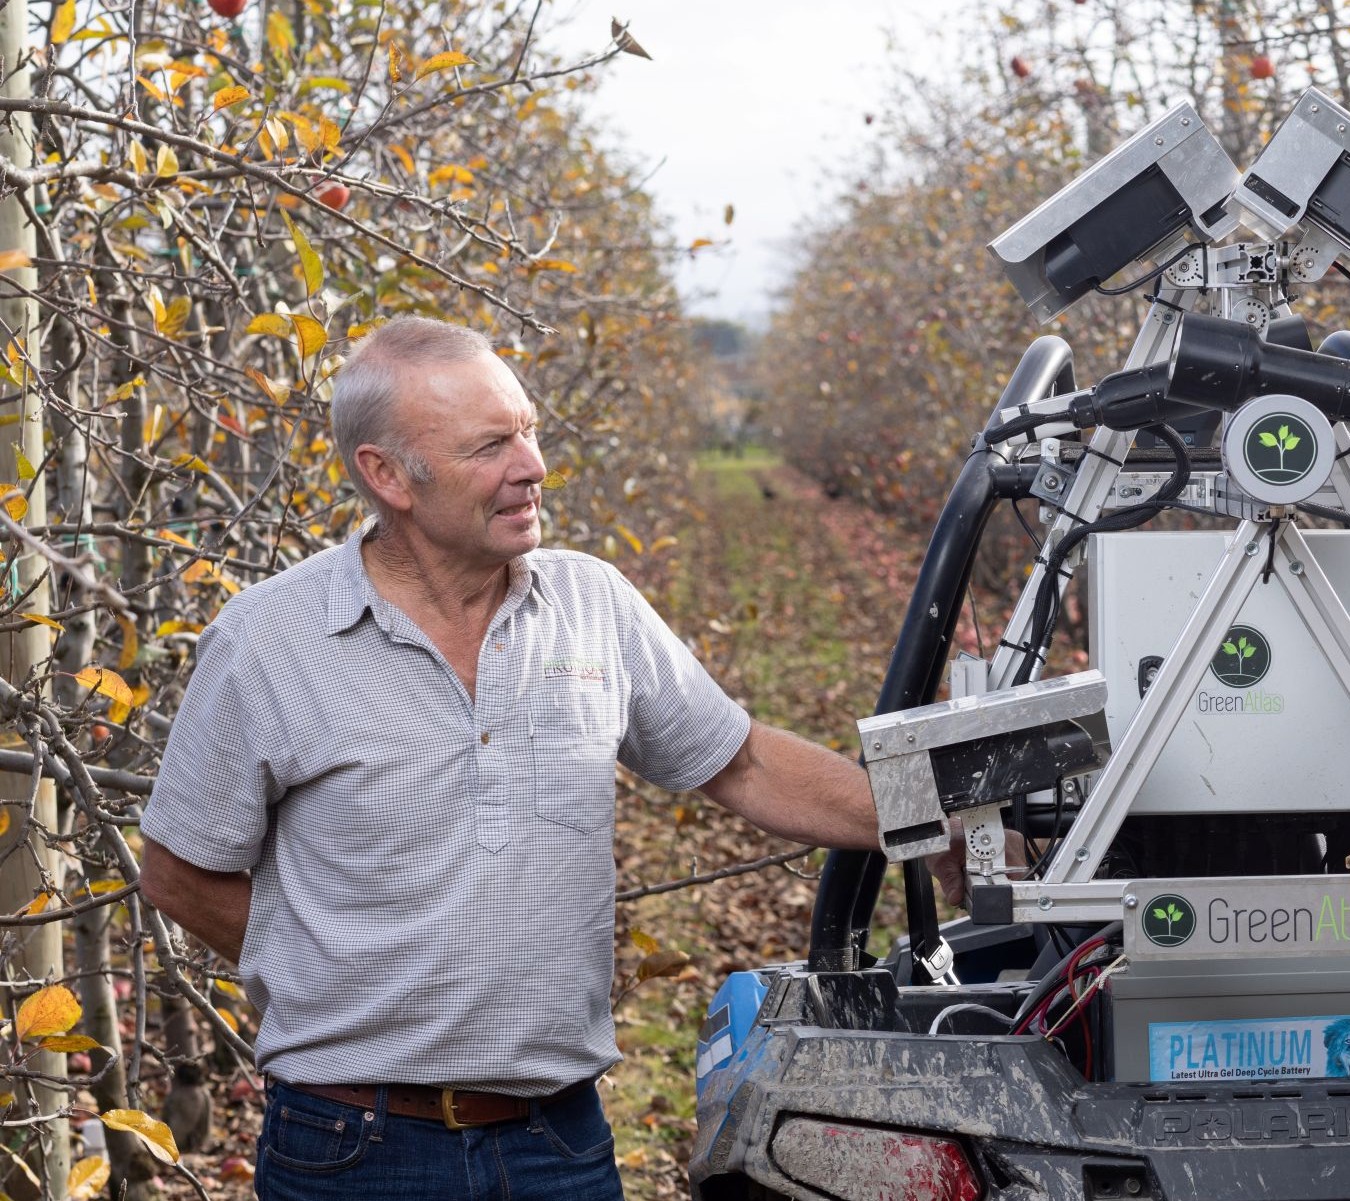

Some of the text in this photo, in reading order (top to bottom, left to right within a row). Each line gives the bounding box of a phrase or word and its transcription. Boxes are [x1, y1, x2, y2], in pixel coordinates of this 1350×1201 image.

[1199, 691, 1282, 712] GreenAtlas
[1169, 1029, 1312, 1069] PLATINUM
[1171, 1066, 1311, 1080] Latest Ultra Gel Deep Cycle Battery
